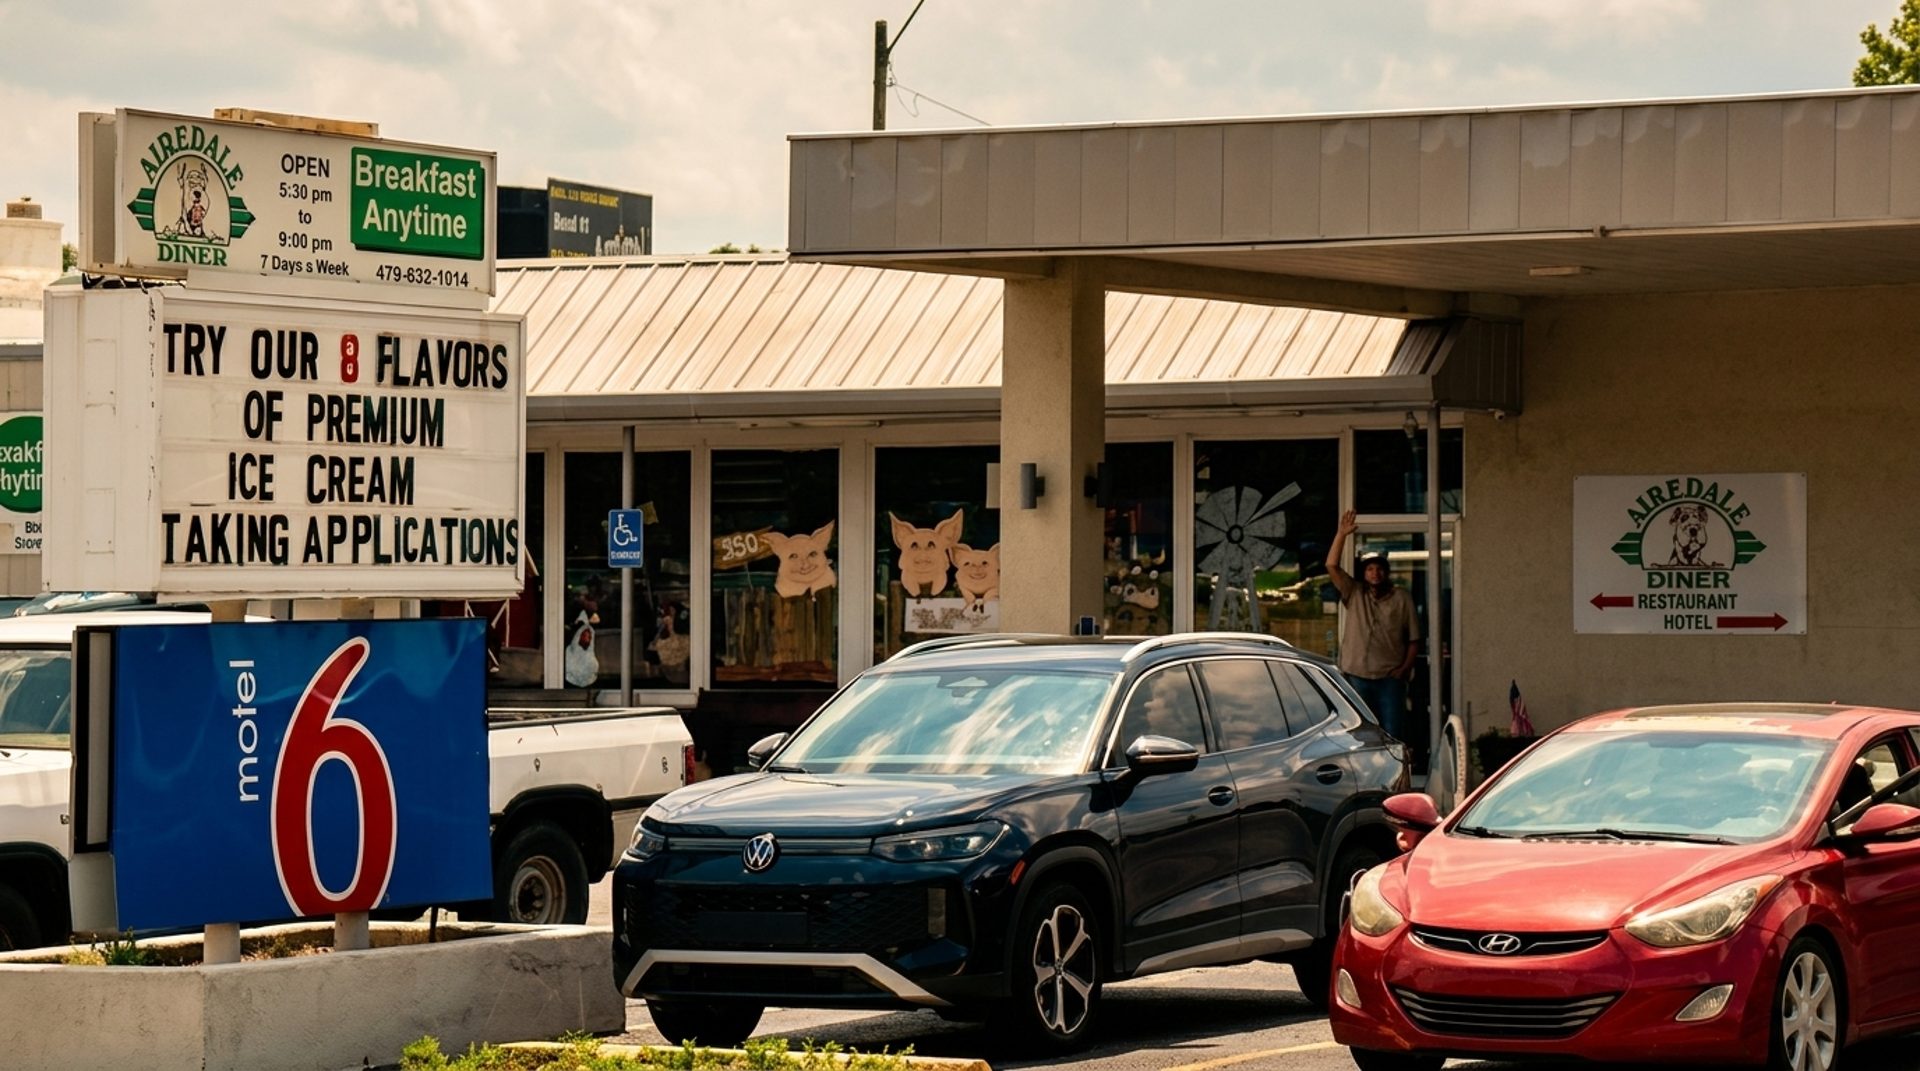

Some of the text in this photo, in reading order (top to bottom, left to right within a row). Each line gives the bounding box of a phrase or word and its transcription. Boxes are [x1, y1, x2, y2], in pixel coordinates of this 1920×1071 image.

[140, 124, 244, 191] AIREDALE
[281, 154, 330, 178] OPEN
[279, 182, 332, 203] 5:30 pm
[355, 155, 477, 199] Breakfast
[298, 208, 312, 225] to
[363, 199, 467, 242] Anytime
[157, 243, 227, 267] DINER
[279, 231, 332, 252] 9:00 pm
[260, 254, 268, 270] 7
[271, 255, 303, 276] Days
[316, 259, 350, 276] Week
[376, 264, 469, 287] 479-632-1014
[163, 323, 509, 389] TRY OUR 8 FLAVORS
[244, 390, 445, 447] OF PREMIUM
[228, 452, 414, 505] ICE CREAM
[1627, 477, 1750, 528] AIREDALE
[162, 513, 519, 566] TAKING APPLICATIONS
[1648, 571, 1730, 589] DINER
[1638, 593, 1738, 609] RESTAURANT
[1664, 615, 1712, 629] HOTEL
[229, 660, 259, 802] motel
[270, 636, 397, 917] 6
